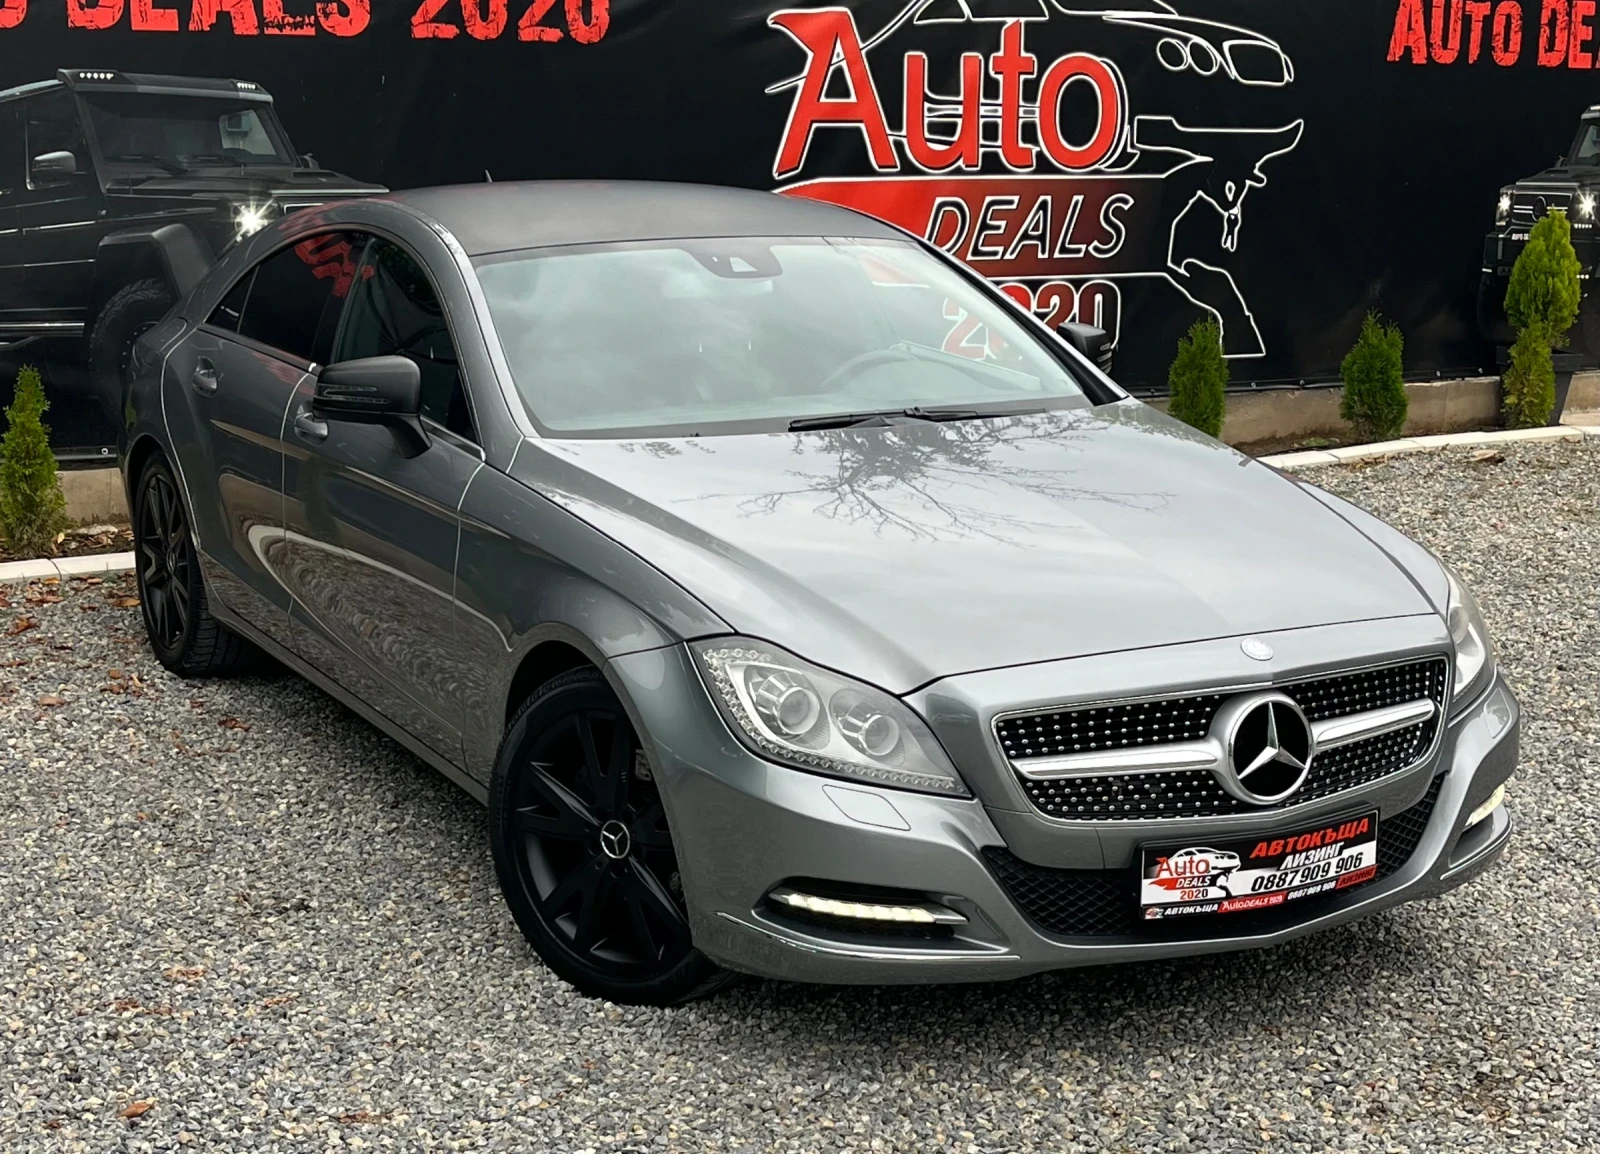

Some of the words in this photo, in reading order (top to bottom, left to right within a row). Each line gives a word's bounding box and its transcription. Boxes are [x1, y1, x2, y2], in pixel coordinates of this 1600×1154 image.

[1387, 0, 1524, 66] AUTO
[1537, 0, 1600, 69] DE
[769, 7, 1119, 178] Auto
[924, 193, 1135, 261] DEALS
[1249, 818, 1369, 858] АВТОКЪЩА
[1155, 856, 1211, 879] Auto
[1280, 841, 1344, 870] ЛИЗИНГ
[1335, 852, 1364, 874] 906
[1176, 876, 1211, 888] DEALS
[1180, 888, 1208, 900] 2020
[1164, 904, 1219, 915] АВТОКЪЩА
